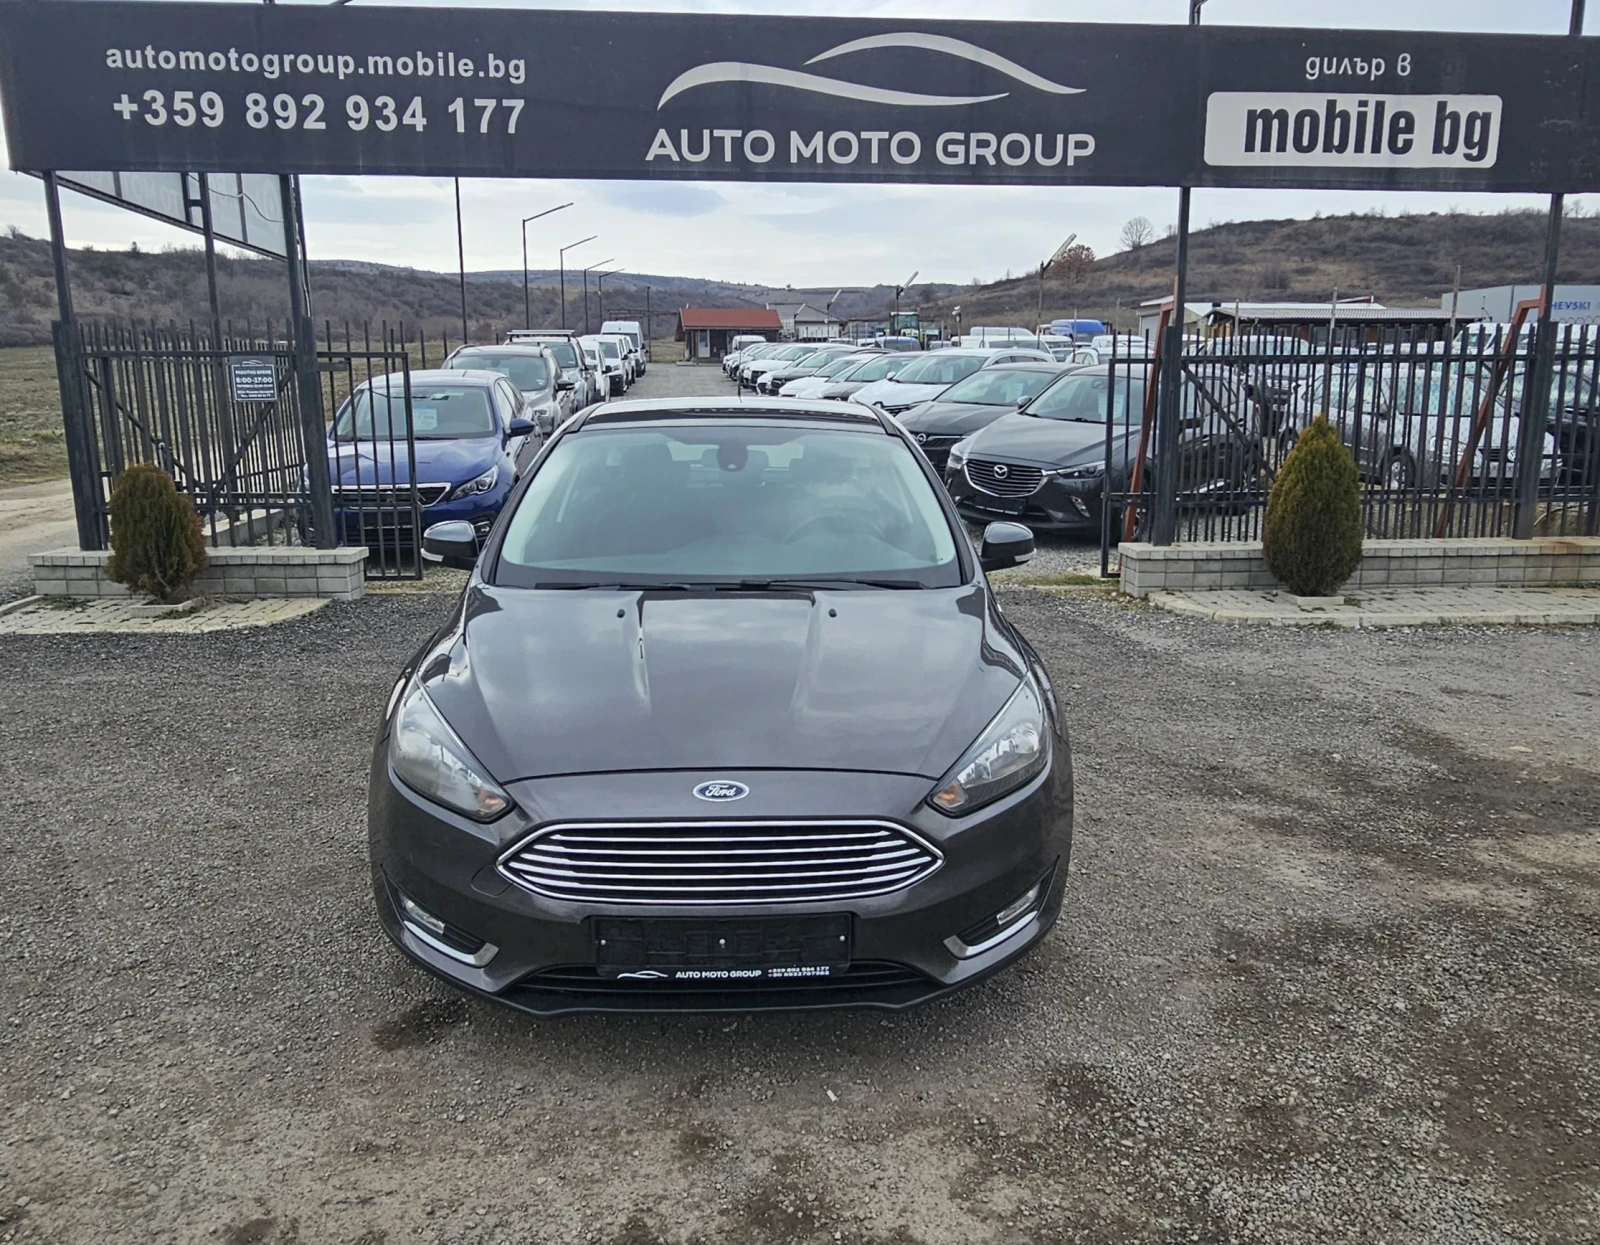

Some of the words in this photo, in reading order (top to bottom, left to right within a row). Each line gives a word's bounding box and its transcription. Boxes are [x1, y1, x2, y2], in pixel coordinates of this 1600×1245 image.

[106, 45, 526, 84] automotogroup.mobile.bg
[1305, 56, 1385, 80] дилър
[1396, 53, 1411, 76] в
[113, 90, 224, 128] +359
[245, 93, 326, 130] 892
[346, 94, 427, 132] 934
[447, 98, 525, 134] 177
[1243, 99, 1415, 155] mobile
[1432, 101, 1492, 162] bg
[645, 128, 775, 163] AUTO
[790, 131, 922, 164] MOTO
[935, 132, 1096, 166] GROUP
[1552, 301, 1591, 310] HEVSKI
[704, 784, 737, 797] Ford
[730, 970, 762, 978] GROUP
